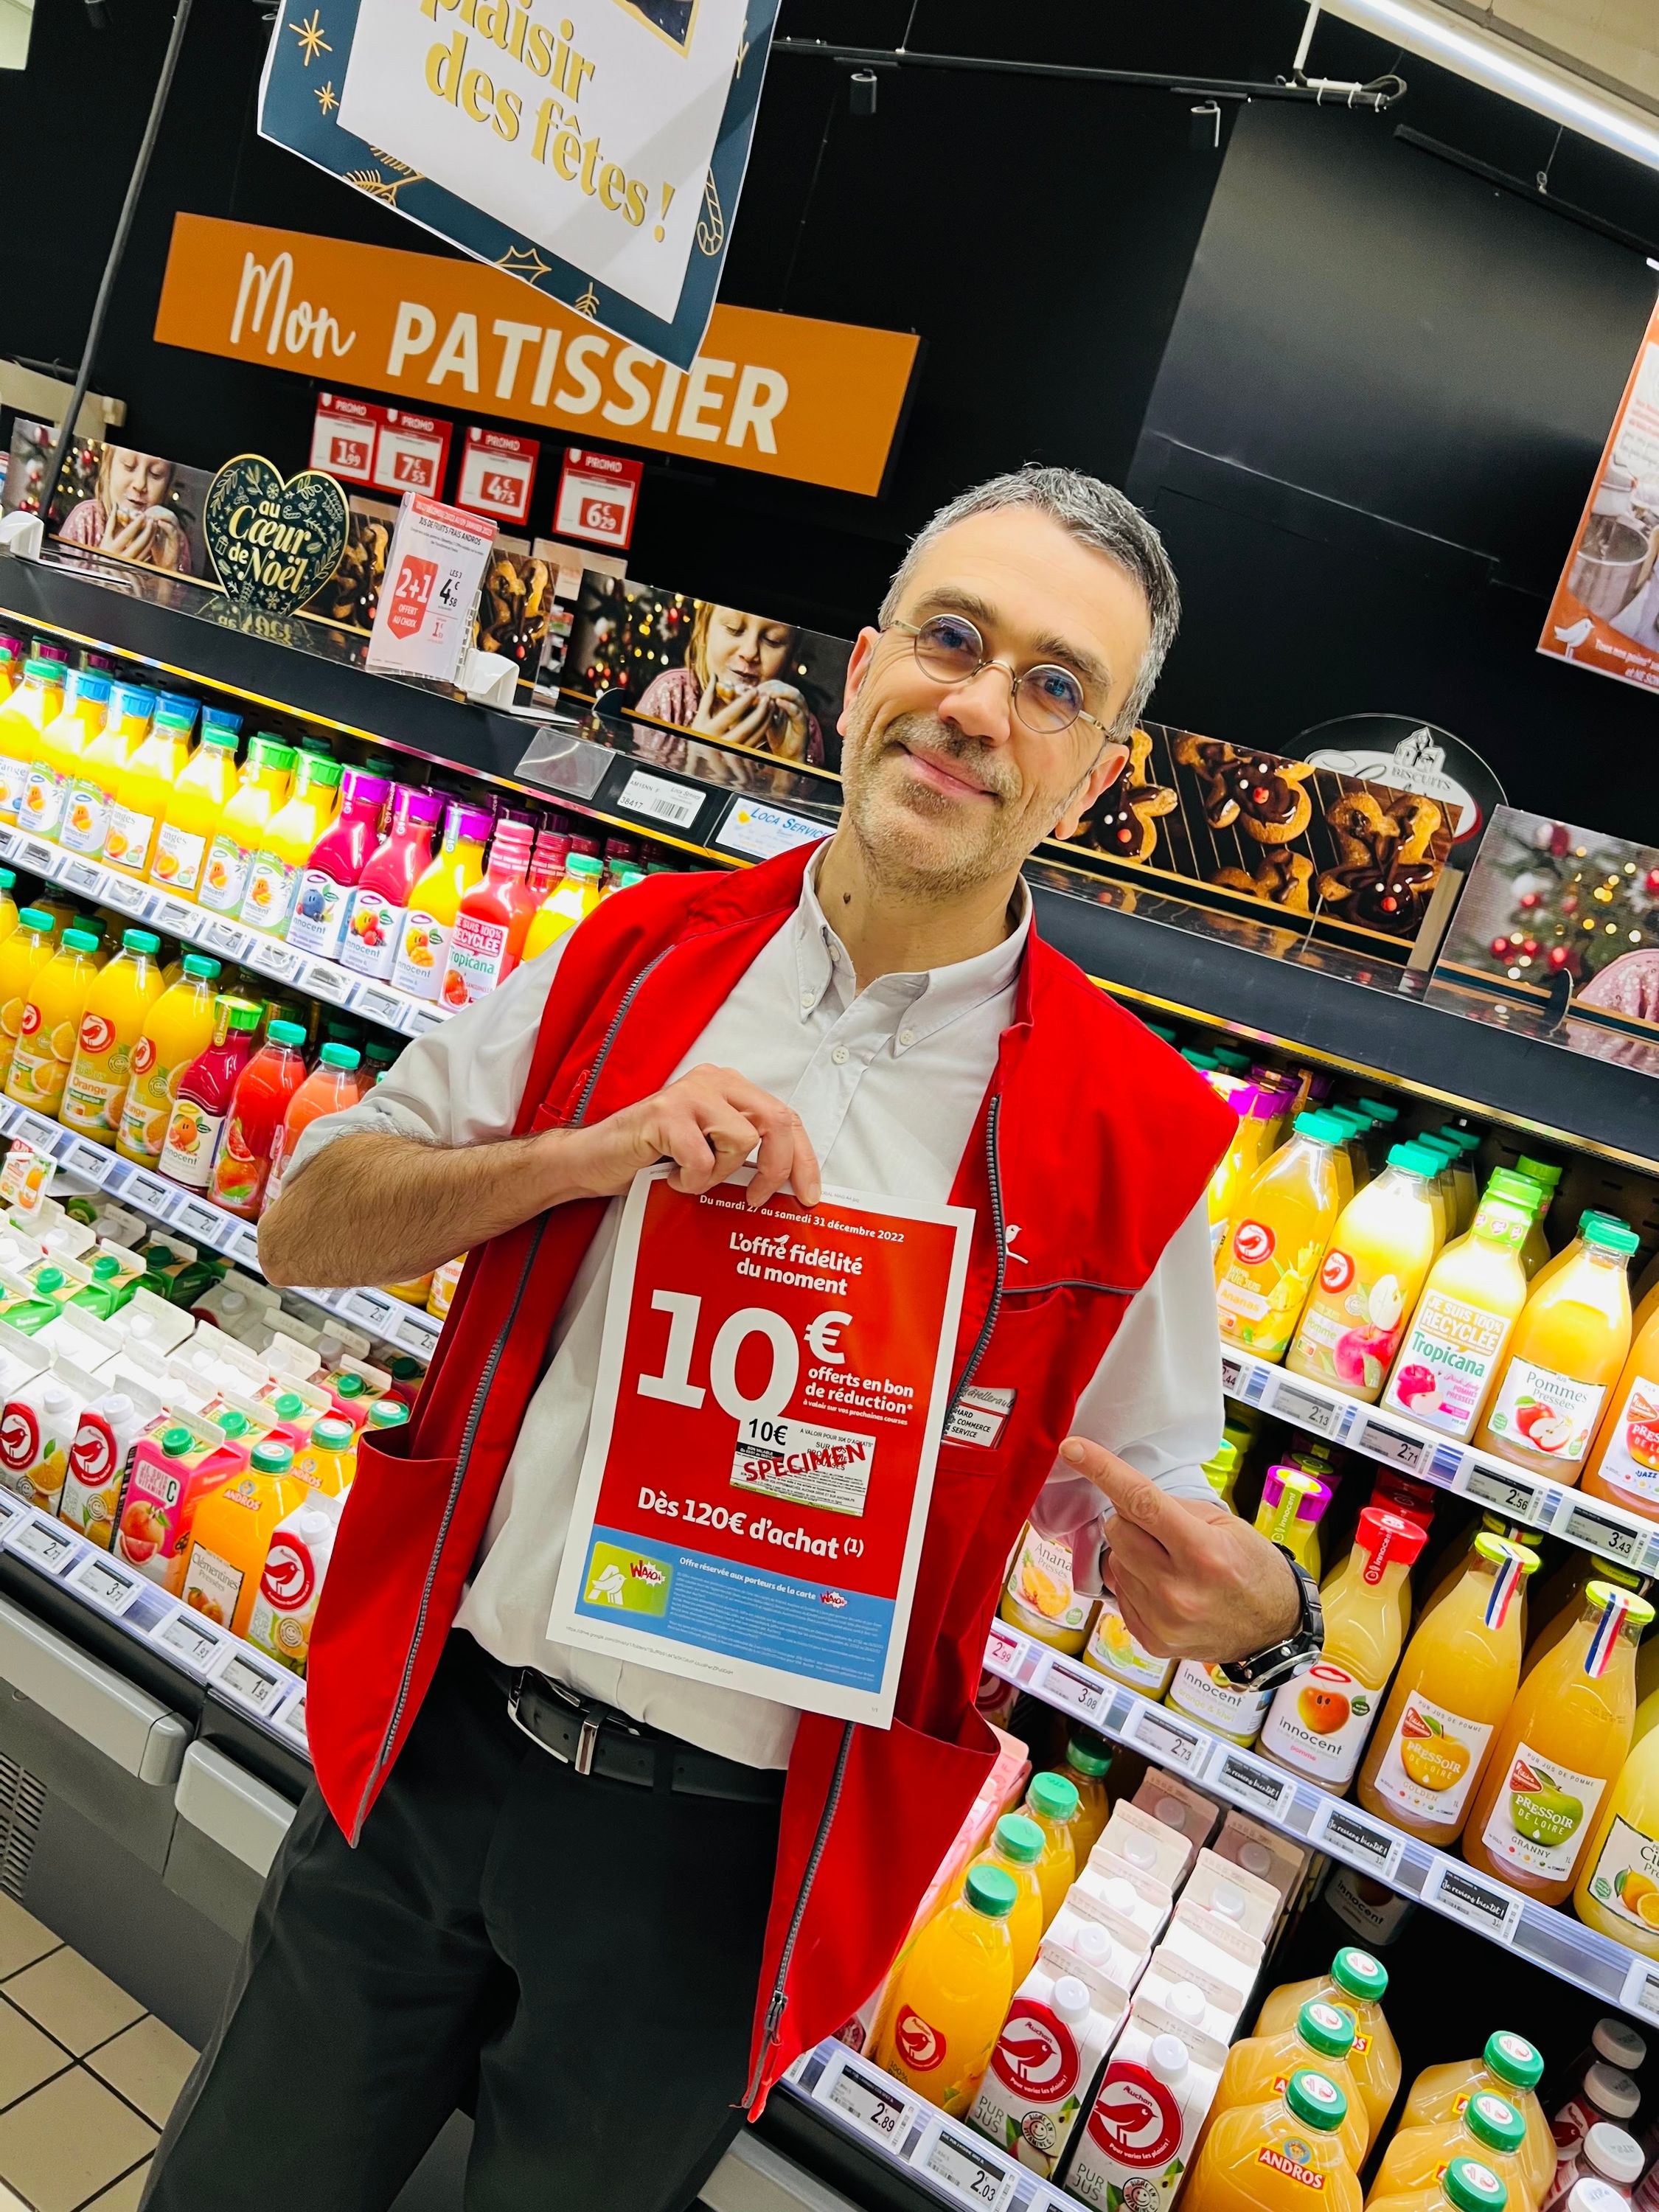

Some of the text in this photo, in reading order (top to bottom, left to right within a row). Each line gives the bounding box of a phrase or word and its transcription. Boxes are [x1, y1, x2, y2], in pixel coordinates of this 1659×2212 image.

[425, 29, 675, 243] des fêtes !
[229, 251, 790, 455] Mon PATISSIER
[335, 400, 366, 416] PROMO
[402, 416, 434, 432] PROMO
[486, 434, 521, 452] PROMO
[585, 456, 622, 473] PROMO
[259, 499, 281, 519] au
[229, 505, 311, 554] Cœur
[433, 521, 449, 534] FRUITS
[448, 526, 462, 538] FRAIS
[461, 530, 482, 546] ANDROS
[228, 542, 310, 594] de Noël
[450, 569, 458, 577] LES
[395, 568, 431, 604] 2+1
[392, 617, 417, 627] AU CHOIX
[398, 604, 418, 616] OFFERT
[620, 796, 644, 808] 38417
[751, 807, 781, 827] LOCA
[462, 919, 502, 939] SUIS 100%
[449, 945, 495, 975] Tropicana
[73, 1077, 108, 1096] Orange
[700, 1195, 714, 1205] Du
[715, 1199, 745, 1211] mardi
[761, 1208, 773, 1217] au
[774, 1210, 812, 1225] samedi
[813, 1217, 826, 1227] 31
[827, 1220, 876, 1238] décembre
[877, 1230, 905, 1243] 2022
[790, 1244, 863, 1276] fidélité
[737, 1258, 848, 1295] du moment
[1220, 1289, 1261, 1312] Ananas
[1427, 1296, 1503, 1333] JE SUIS 100%
[1307, 1318, 1338, 1340] Pomme
[1412, 1330, 1486, 1377] Tropicana
[805, 1382, 826, 1399] de
[808, 1366, 914, 1398] offerts en bon
[1453, 1385, 1478, 1398] POMMES
[1526, 1371, 1588, 1404] Pommes
[809, 1399, 827, 1411] valoir
[827, 1405, 838, 1413] sur
[849, 1408, 884, 1422] prochaines
[884, 1415, 908, 1425] courses
[1532, 1388, 1576, 1411] Pressées
[748, 1418, 788, 1446] 10€
[804, 1428, 838, 1441] VALOIR POUR
[950, 1426, 978, 1438] SERVICE
[957, 1418, 992, 1433] COMMERCE
[815, 1441, 830, 1450] SUR
[1634, 1437, 1646, 1447] DE
[743, 1442, 866, 1483] SPECIMEN
[223, 1489, 261, 1511] ANDROS
[1280, 1492, 1296, 1530] innocent
[638, 1486, 864, 1559] Dès 120€ d'achat (1)
[1034, 1543, 1073, 1572] Anana
[192, 1552, 239, 1590] Clémentines
[679, 1557, 816, 1601] Offre réservée aux porteurs de la carte
[1183, 1668, 1244, 1707] innocent
[1418, 1700, 1430, 1711] PUR
[1433, 1708, 1445, 1719] JUS
[1458, 1721, 1483, 1733] POMME
[1279, 1716, 1343, 1755] innocent
[1290, 1745, 1317, 1762] pomme
[1407, 1740, 1461, 1774] PRESSOIR
[1409, 1754, 1453, 1780] DE LOIRE
[1527, 1752, 1595, 1787] PUR JUS DE POMME
[1402, 1780, 1439, 1802] GOLDEN
[1515, 1794, 1574, 1829] PRESSOIR
[1517, 1809, 1565, 1836] DE LOIRE
[1511, 1835, 1551, 1858] GRANNY
[1337, 1879, 1384, 1925] innocent
[1024, 2021, 1053, 2044] Auchan
[1009, 2076, 1066, 2095] Pour varier les plaisirs
[1123, 2085, 1153, 2107] Auchan
[975, 2107, 999, 2134] JUS
[979, 2095, 1004, 2124] PUR
[1023, 2127, 1046, 2148] VITAMINE
[1044, 2120, 1054, 2132] EN
[1109, 2142, 1123, 2155] Pour
[1124, 2152, 1142, 2160] varier
[1152, 2143, 1168, 2159] plaisirs
[1077, 2163, 1105, 2190] PUR
[1259, 2149, 1324, 2190] ANDROS
[1073, 2174, 1102, 2202] JUS
